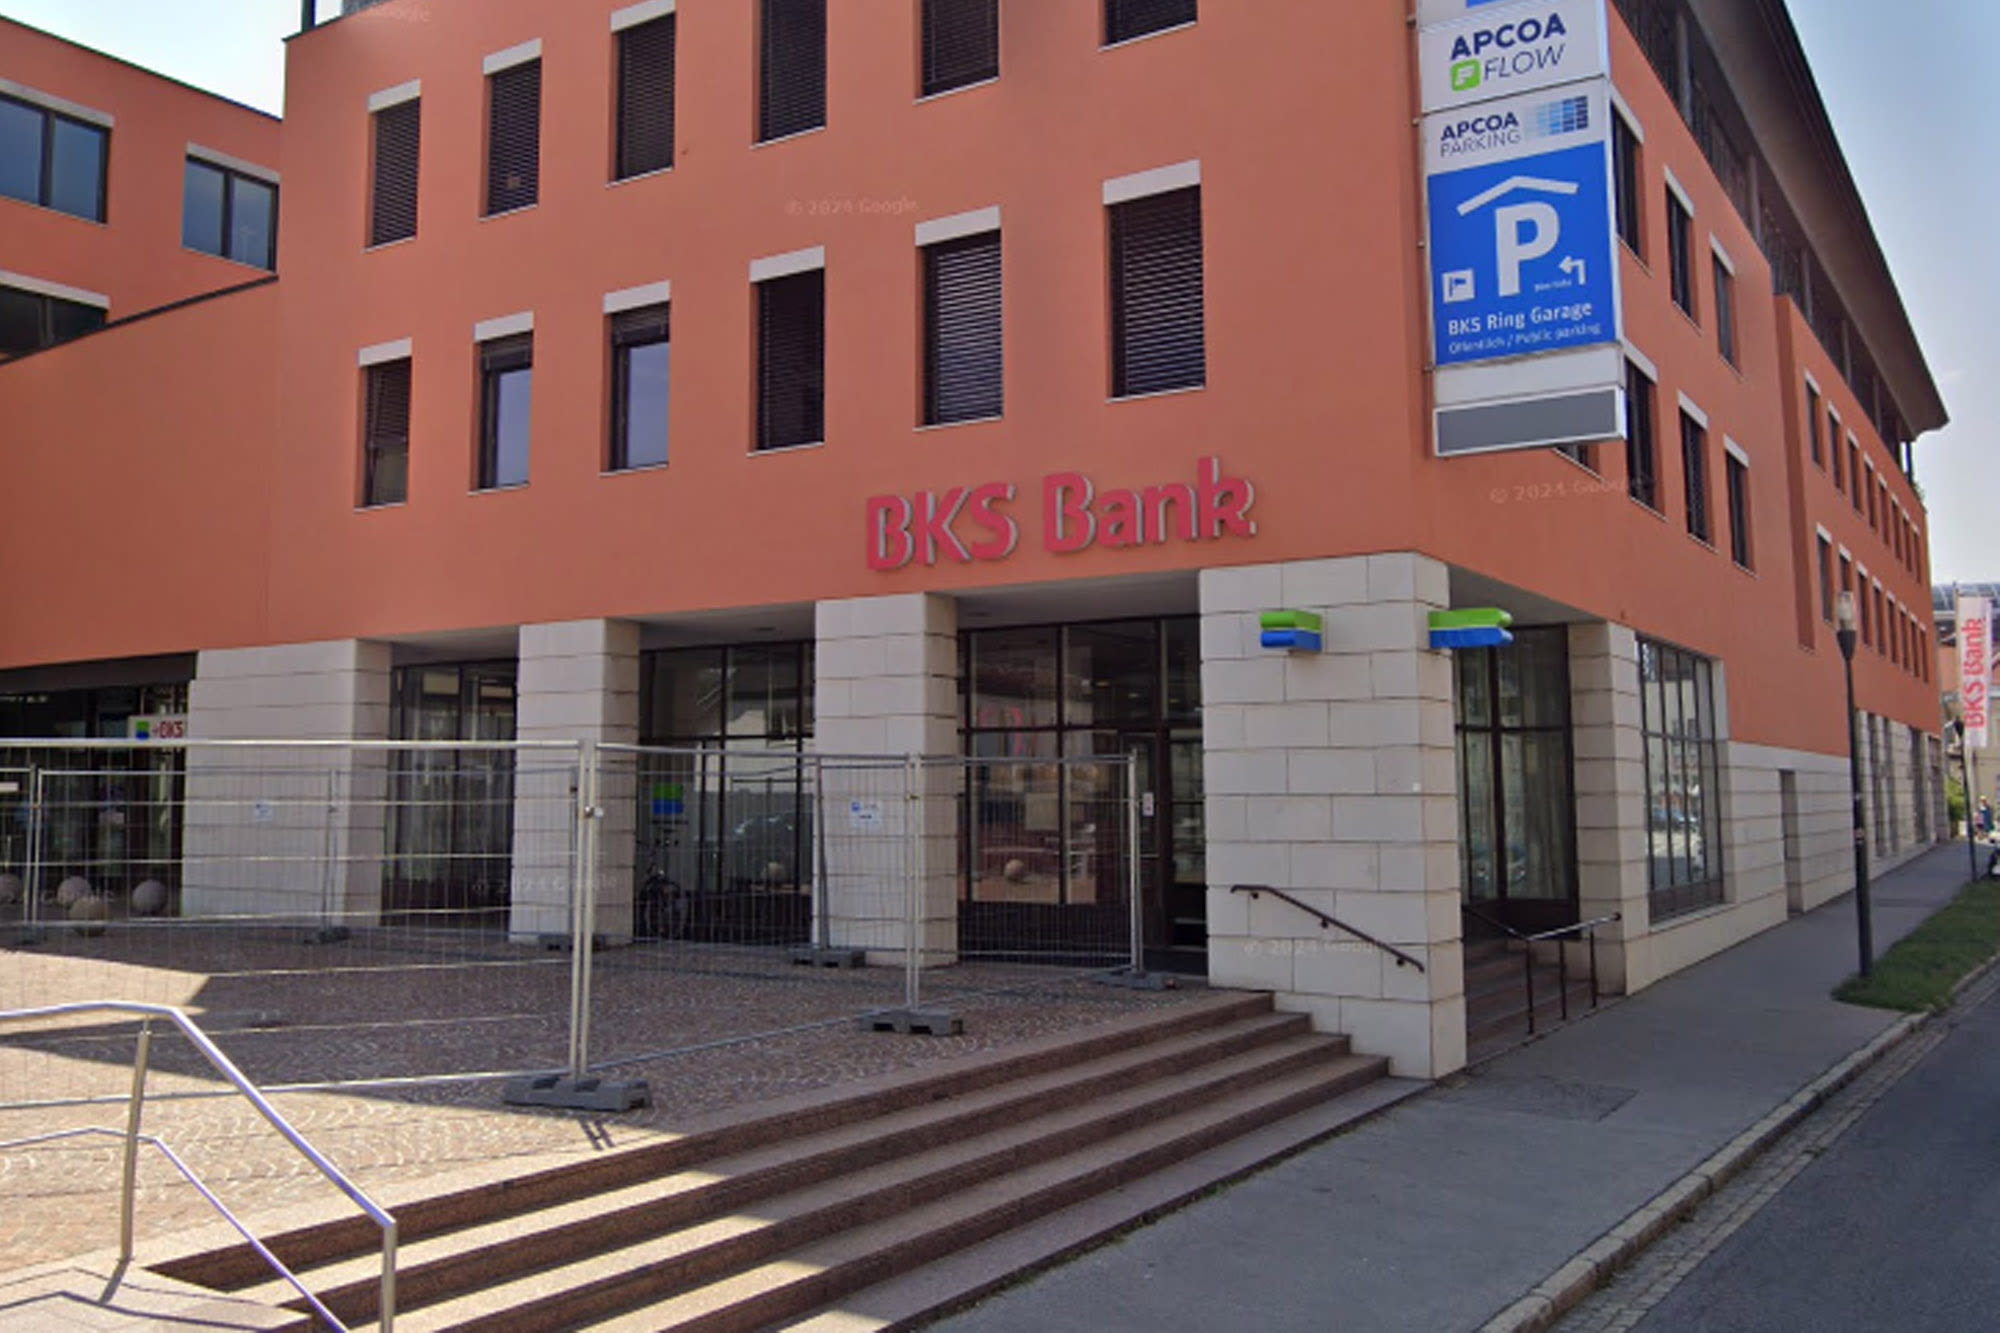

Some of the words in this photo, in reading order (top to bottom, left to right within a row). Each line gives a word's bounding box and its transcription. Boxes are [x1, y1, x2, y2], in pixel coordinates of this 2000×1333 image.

[1451, 13, 1567, 61] APCOA
[1483, 44, 1566, 81] FLOW
[1440, 112, 1520, 142] APCOA
[1440, 129, 1522, 158] PARKING
[1495, 201, 1560, 297] P
[1448, 316, 1481, 336] BKS
[1487, 311, 1526, 331] Ring
[1530, 302, 1593, 325] Garage
[866, 482, 1019, 572] BKS
[1043, 456, 1258, 554] Bank
[1961, 617, 1987, 676] Bank
[1963, 682, 1986, 728] BKS
